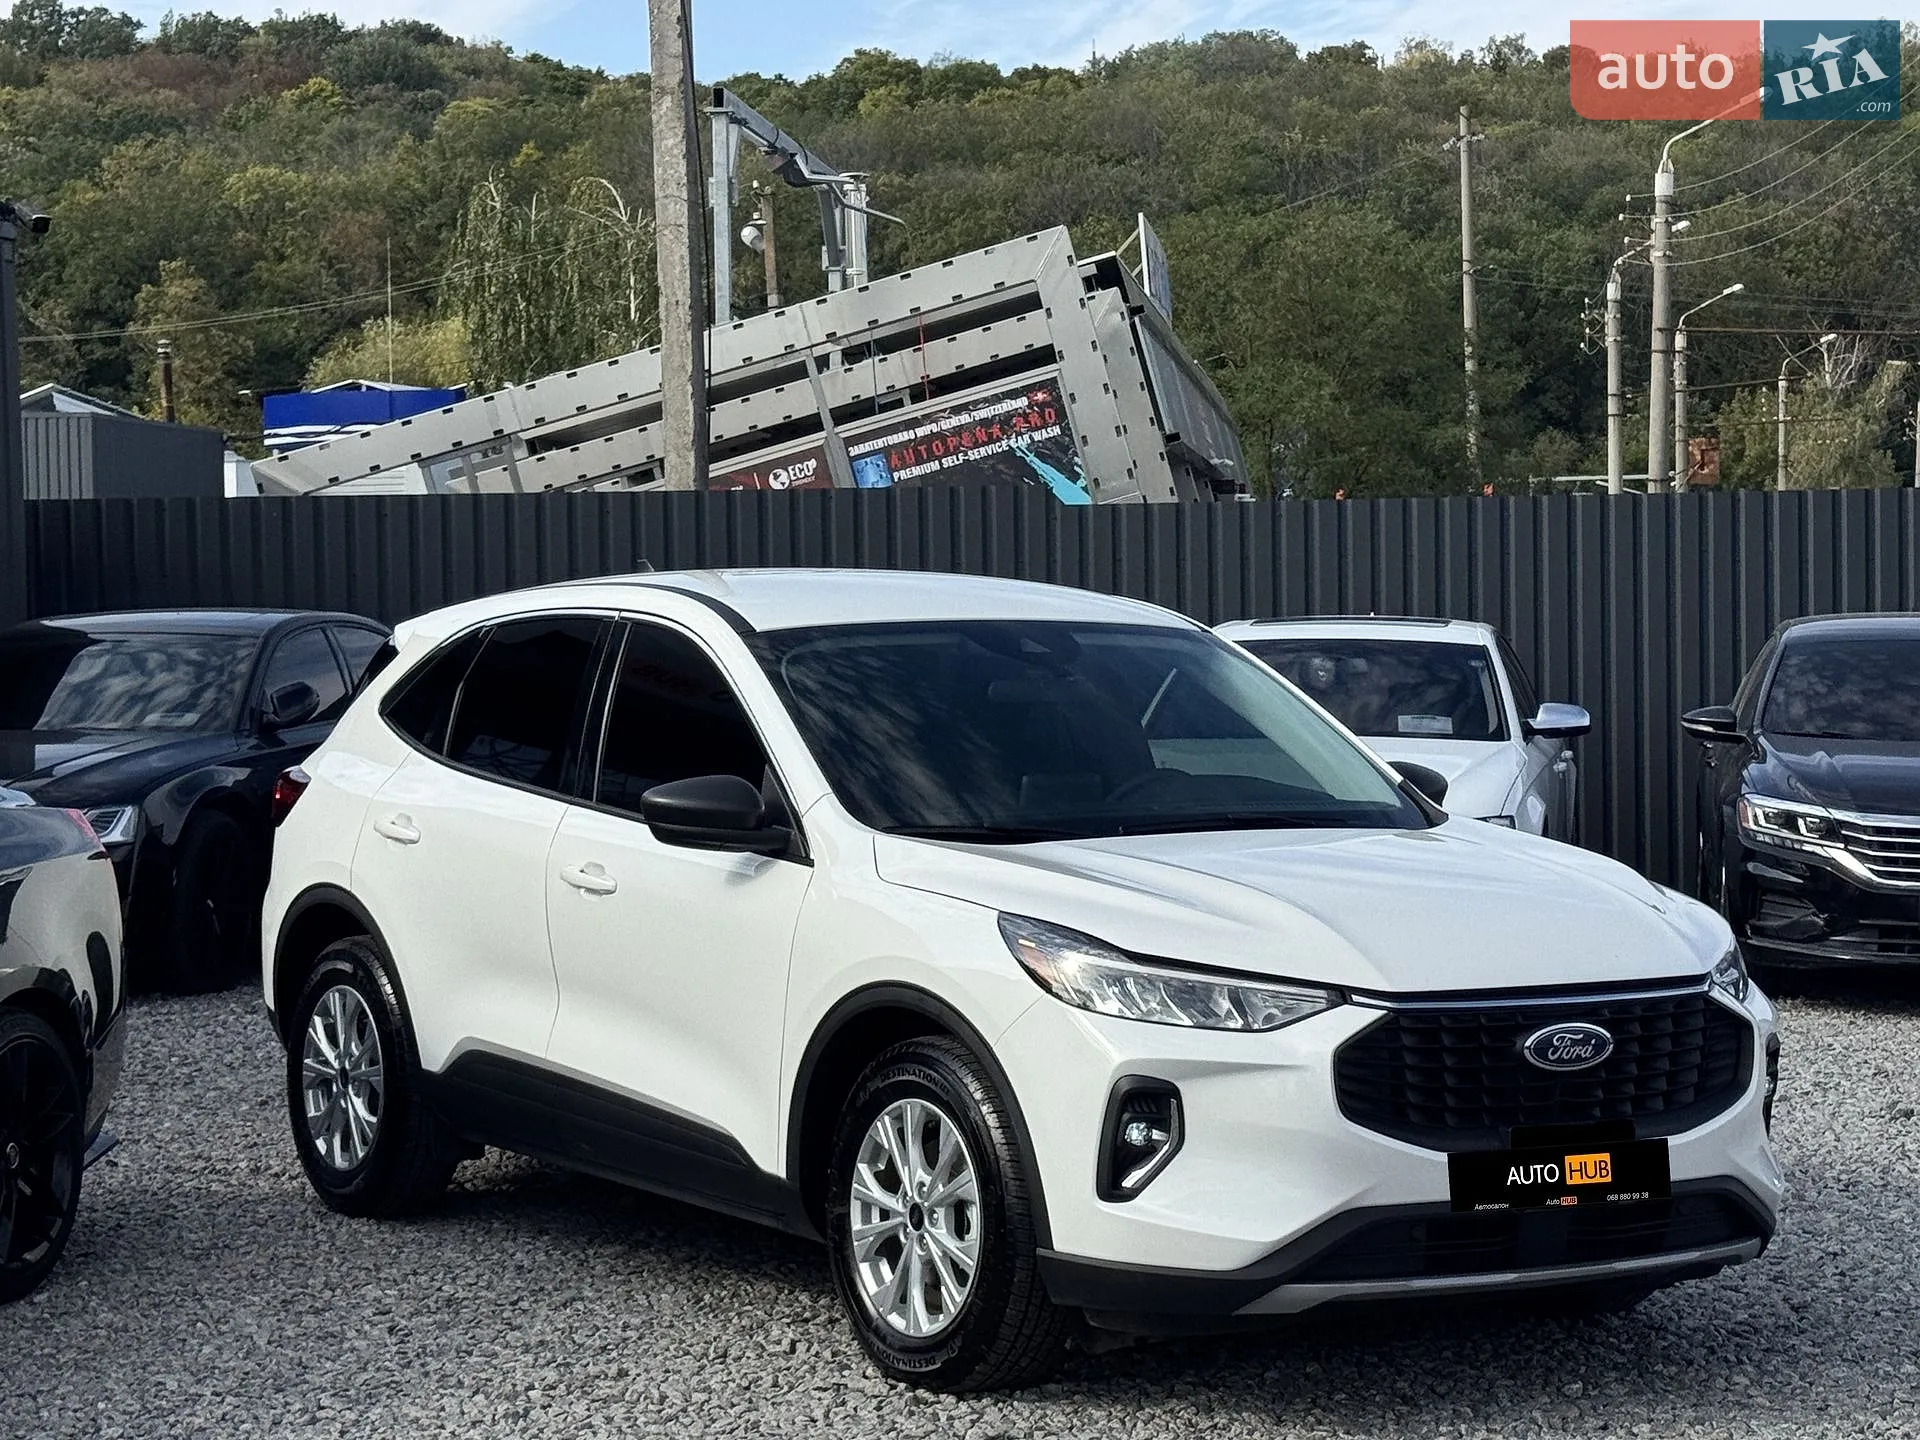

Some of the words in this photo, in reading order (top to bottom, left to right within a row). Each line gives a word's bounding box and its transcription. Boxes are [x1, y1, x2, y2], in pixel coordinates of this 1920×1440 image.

[893, 460, 940, 482] PREMIUM
[942, 438, 1010, 469] SELF-SERVICE
[1009, 431, 1031, 449] CAR
[1030, 424, 1062, 442] WASH
[788, 460, 814, 480] ECO
[1548, 1033, 1596, 1060] Ford
[880, 1066, 939, 1088] DESTINATION
[1506, 1163, 1559, 1186] AUTO
[1568, 1159, 1611, 1181] HUB
[1561, 1197, 1577, 1205] HUB
